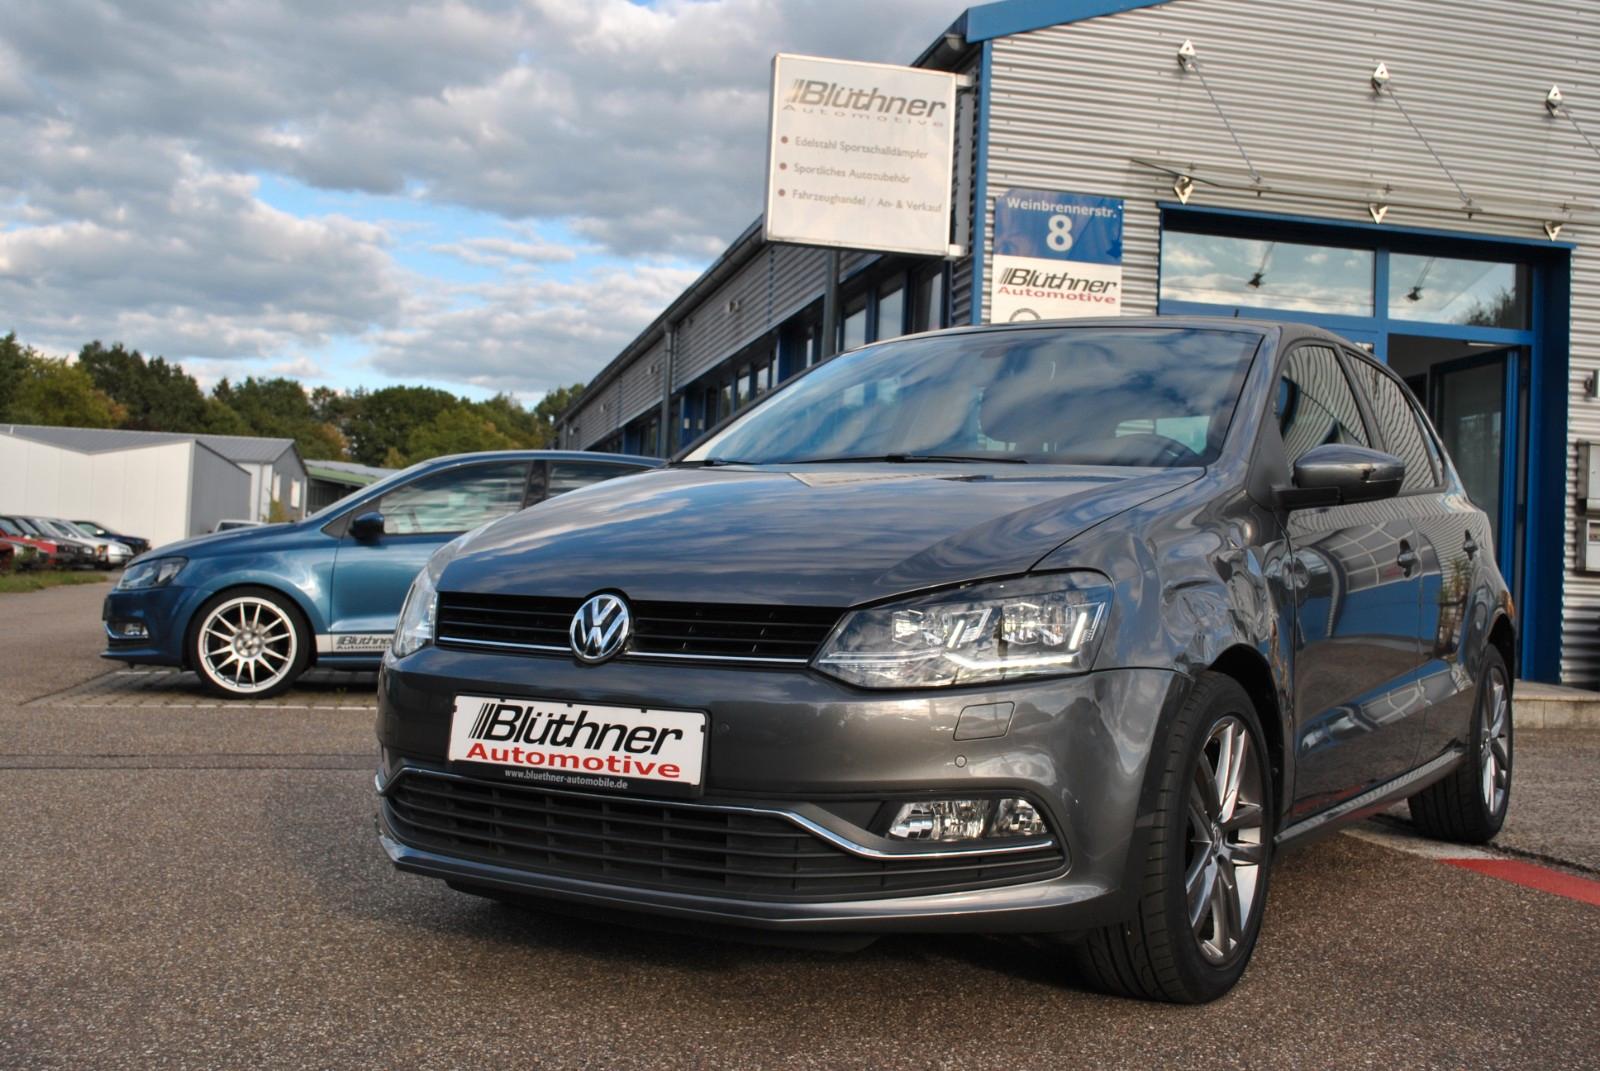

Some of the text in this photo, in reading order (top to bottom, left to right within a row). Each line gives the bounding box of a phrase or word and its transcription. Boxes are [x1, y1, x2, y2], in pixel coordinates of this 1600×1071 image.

[787, 79, 946, 118] Blüthner
[782, 104, 944, 128] Automotive
[795, 136, 929, 160] Edelstahl Sportschalldämpfer
[794, 162, 912, 184] Sportliches Autozubehör
[792, 189, 866, 206] Fahrzeughandel
[896, 199, 904, 209] &
[906, 200, 943, 213] Verkauf
[1006, 197, 1118, 219] Weinbrennerstr.
[1046, 214, 1073, 252] 8
[1000, 267, 1118, 294] Blüthner
[998, 286, 1116, 305] Automotive
[570, 594, 629, 660] VW
[468, 702, 683, 756] Blüthner
[466, 743, 680, 779] Automotive
[504, 768, 629, 790] www.bluethner-automobile.de
